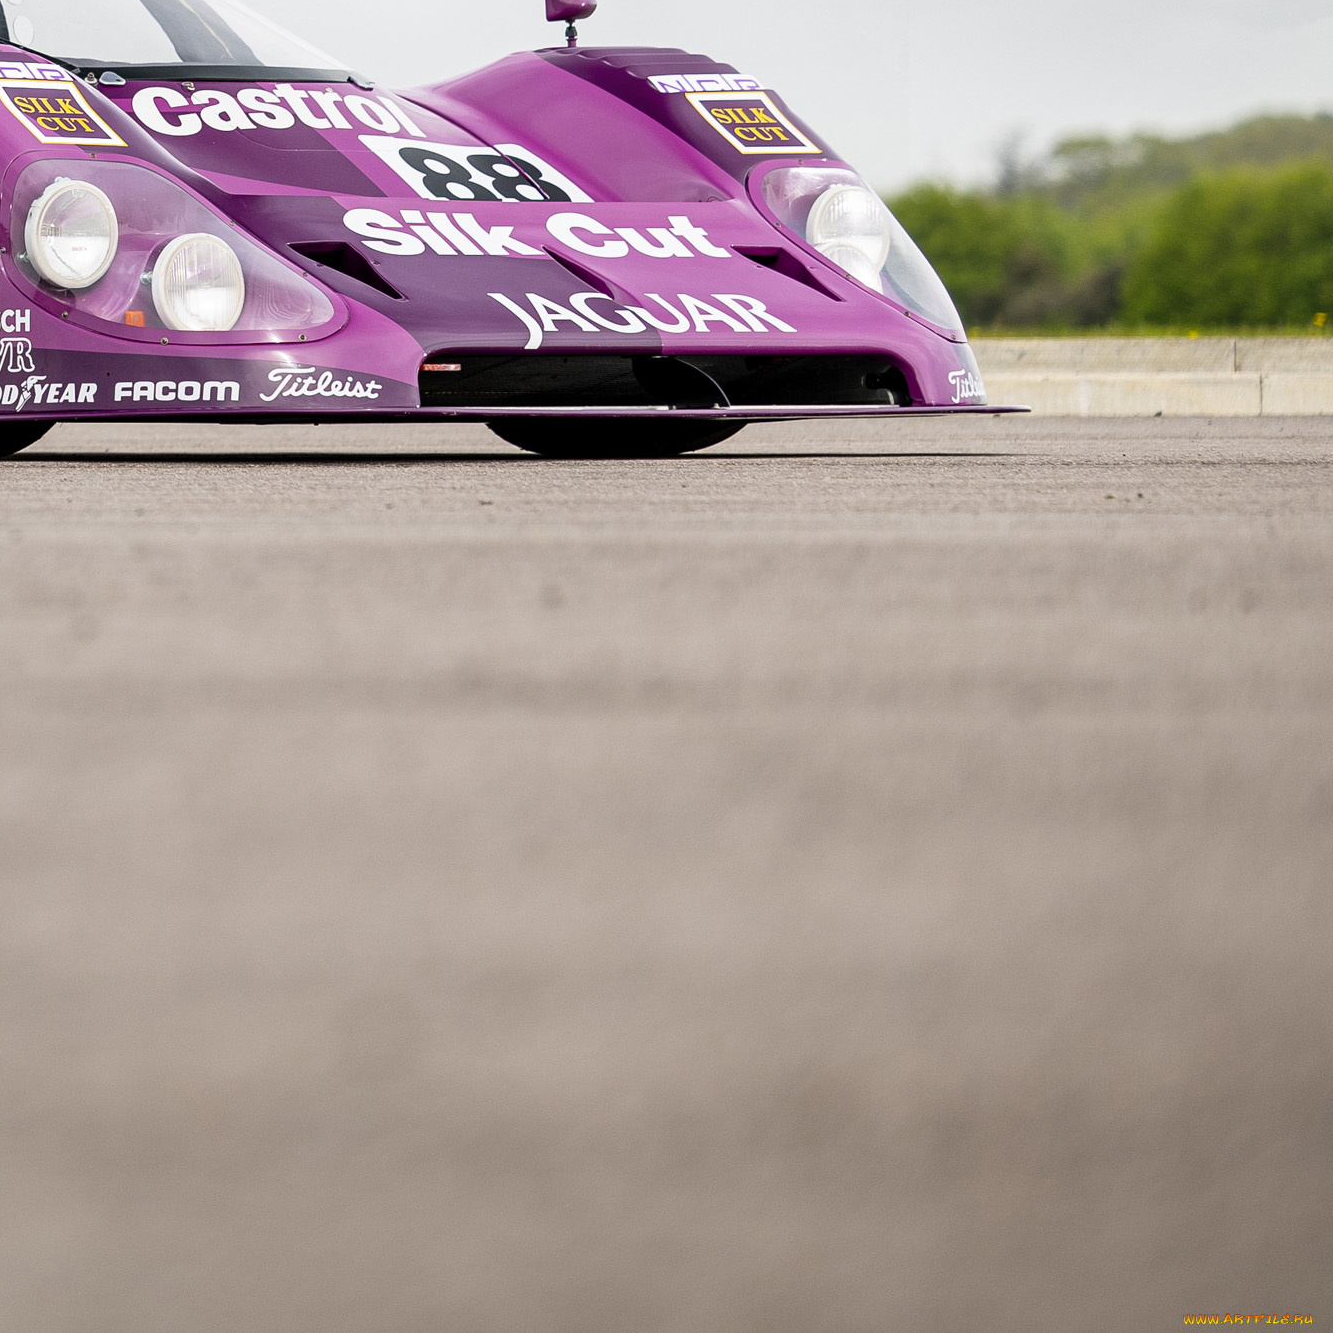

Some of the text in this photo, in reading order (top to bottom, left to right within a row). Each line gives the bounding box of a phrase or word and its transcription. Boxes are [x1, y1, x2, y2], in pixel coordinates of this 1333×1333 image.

[13, 96, 84, 115] SILK
[132, 83, 427, 138] Castrol
[710, 107, 777, 124] SILK
[36, 117, 95, 132] CUT
[734, 126, 790, 141] CUT
[398, 147, 572, 202] 88
[342, 208, 732, 259] Silk Cut
[486, 292, 798, 350] JAGUAR
[114, 381, 240, 402] FACOM
[259, 366, 383, 402] Titleist
